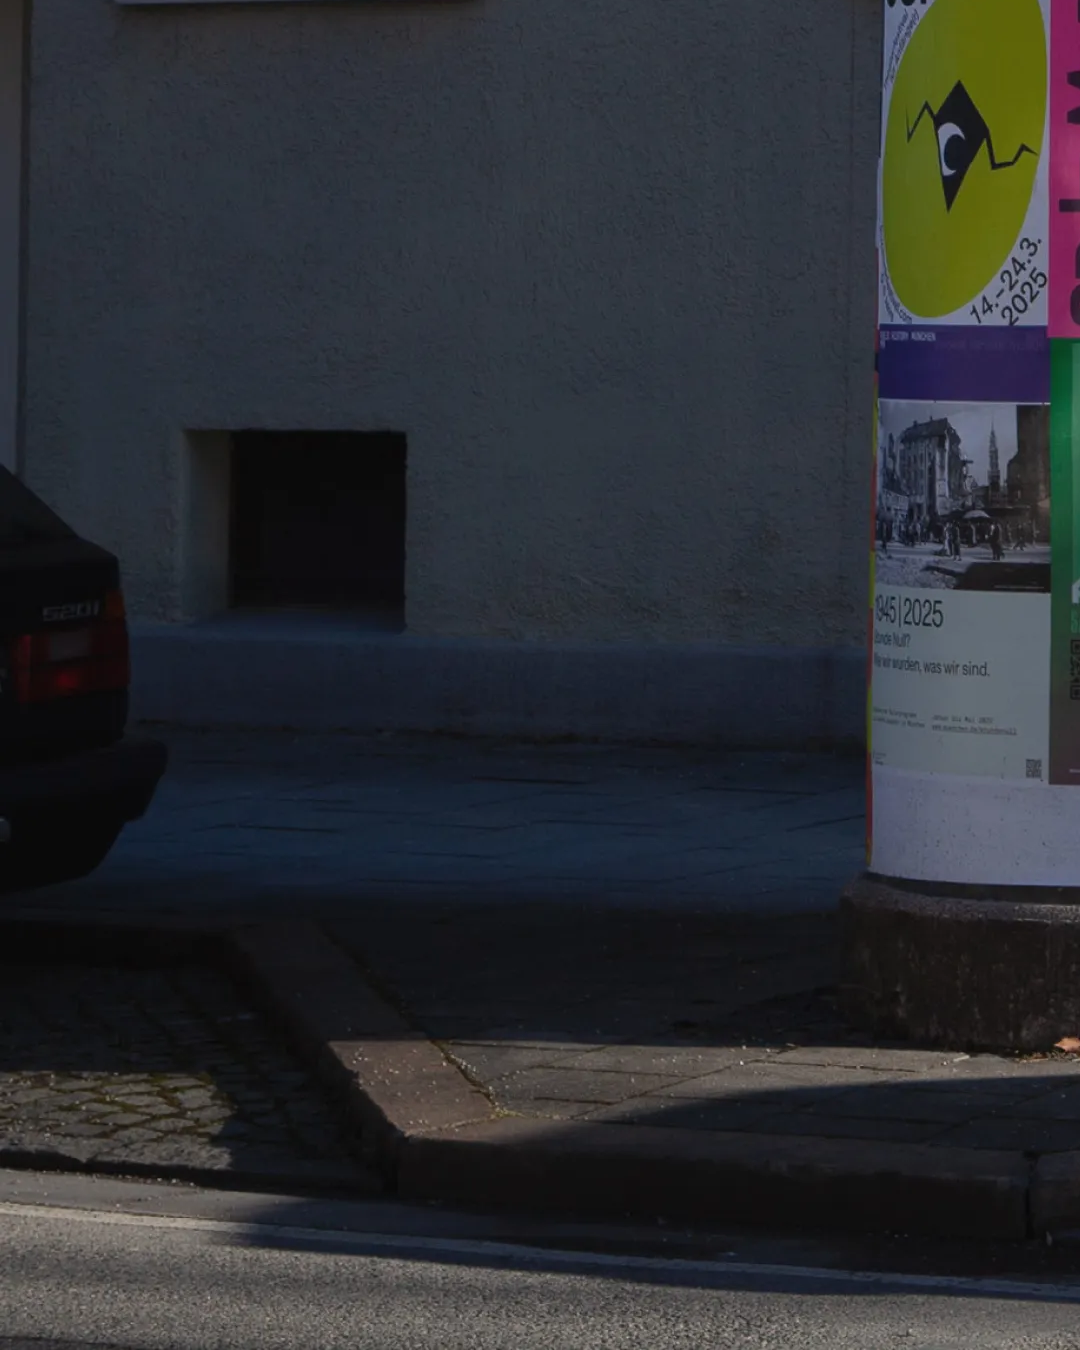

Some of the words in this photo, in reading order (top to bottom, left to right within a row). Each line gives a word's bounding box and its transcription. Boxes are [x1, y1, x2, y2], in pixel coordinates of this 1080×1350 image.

[1001, 266, 1047, 326] 2025
[923, 660, 942, 674] was
[943, 659, 960, 675] wir
[962, 661, 991, 677] sind.
